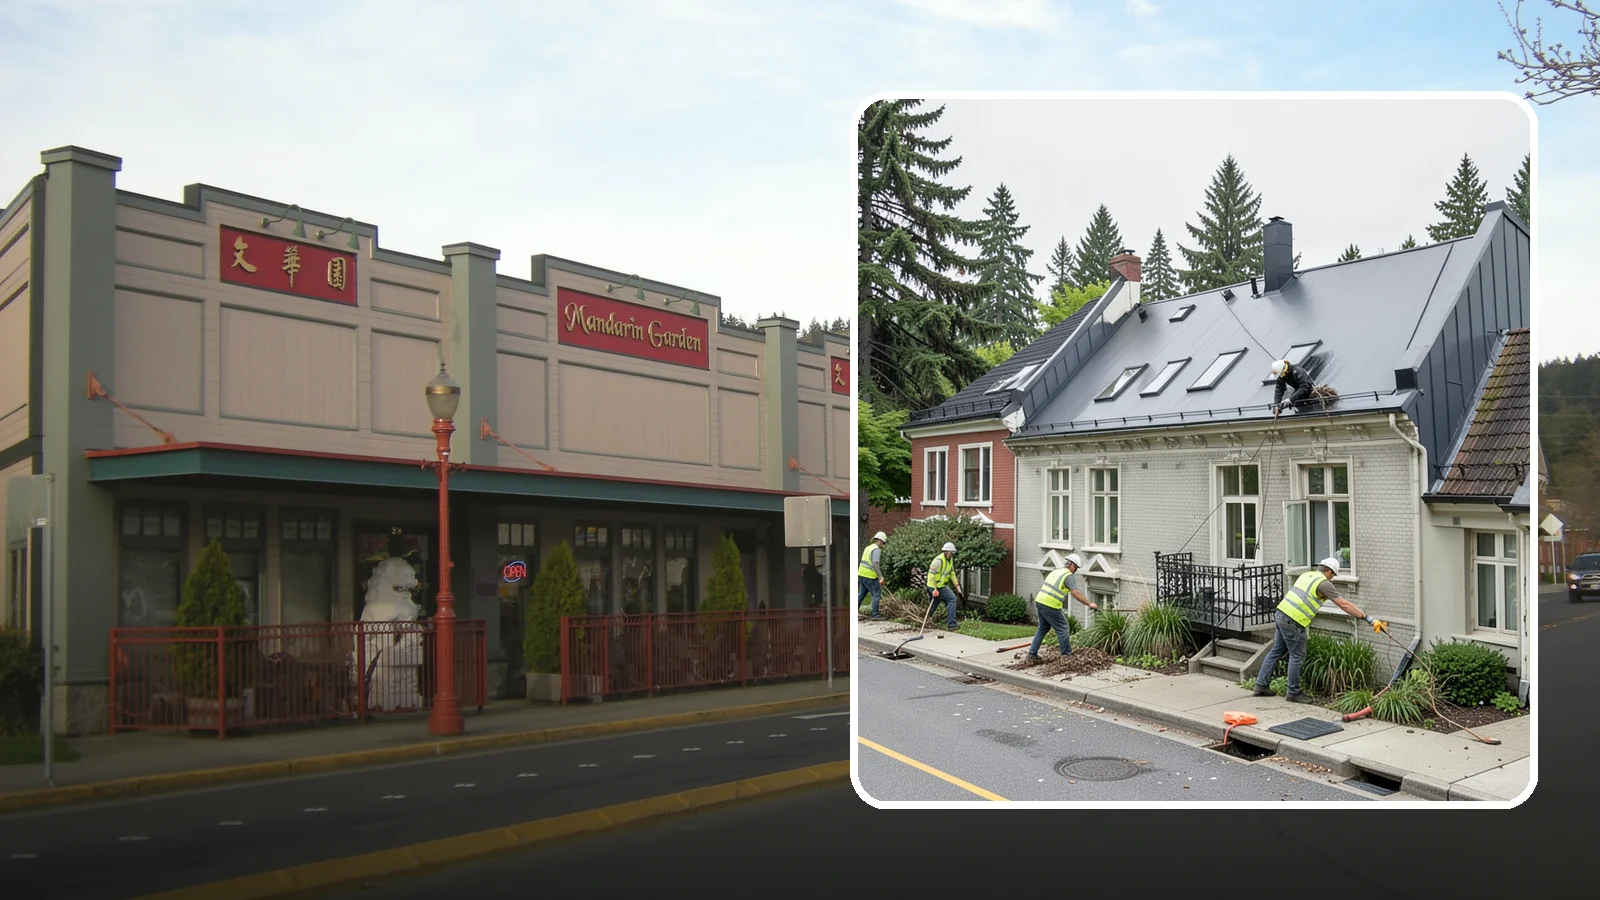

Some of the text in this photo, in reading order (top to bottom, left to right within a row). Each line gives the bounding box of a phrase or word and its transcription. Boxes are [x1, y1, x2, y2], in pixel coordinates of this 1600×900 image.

[231, 236, 346, 291] 文華園
[564, 302, 702, 352] Mandarin Garden
[503, 565, 527, 578] OPEN
